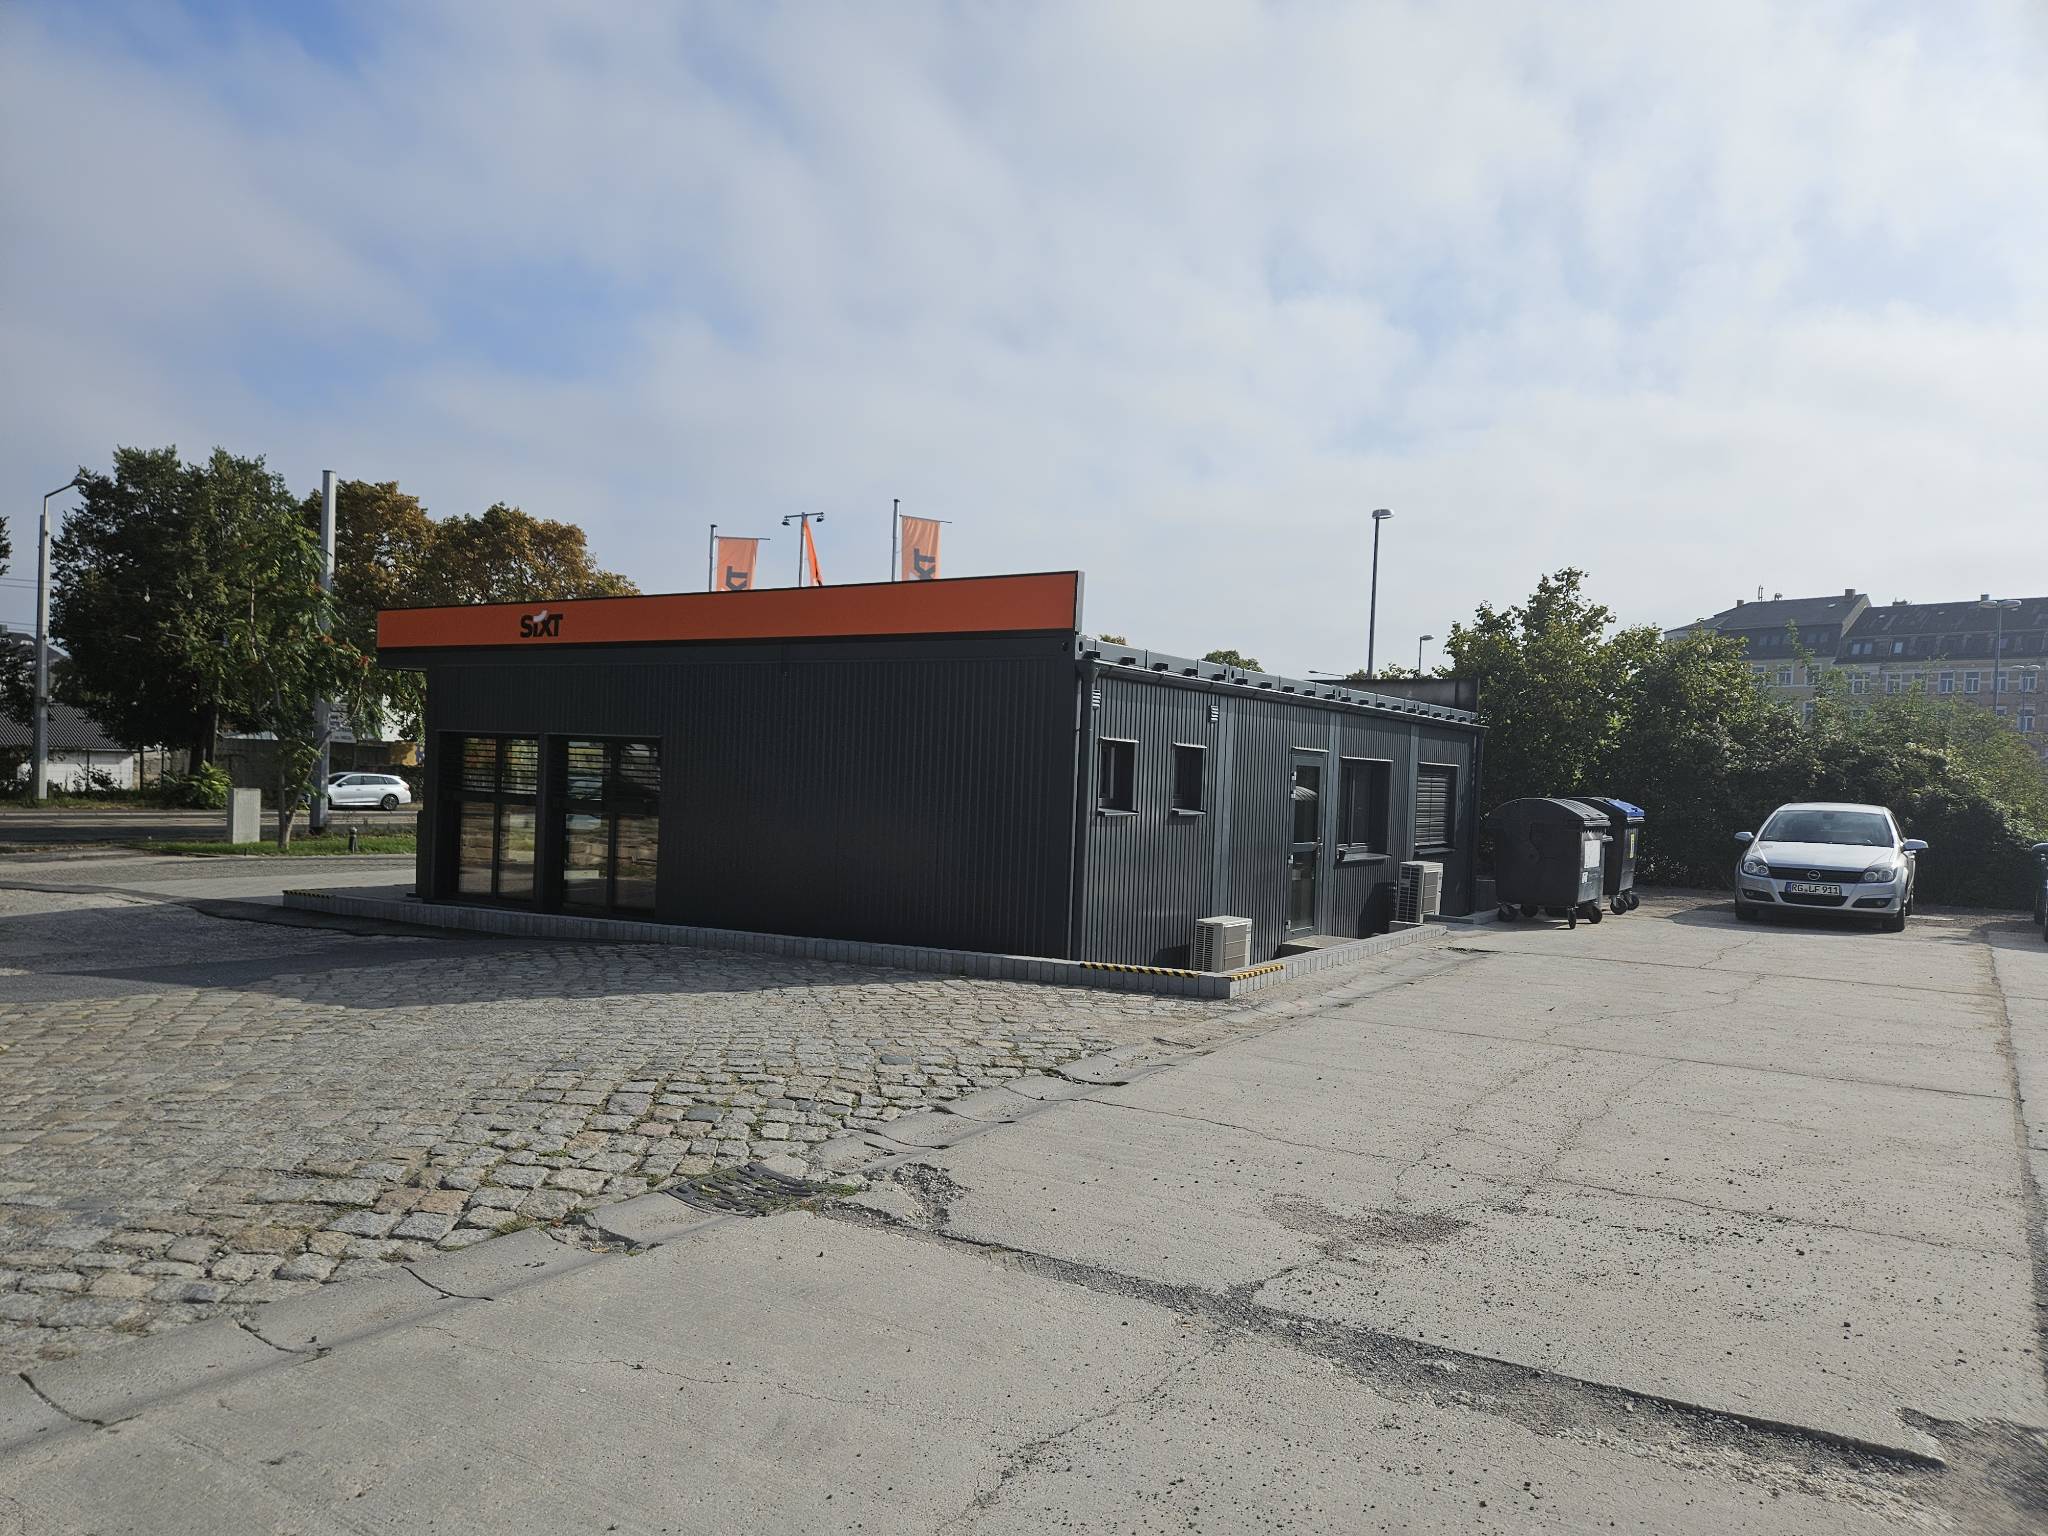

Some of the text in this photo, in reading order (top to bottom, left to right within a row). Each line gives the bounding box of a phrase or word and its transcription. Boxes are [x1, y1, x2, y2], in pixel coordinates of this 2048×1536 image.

[1791, 884, 1839, 895] RG LF 911
